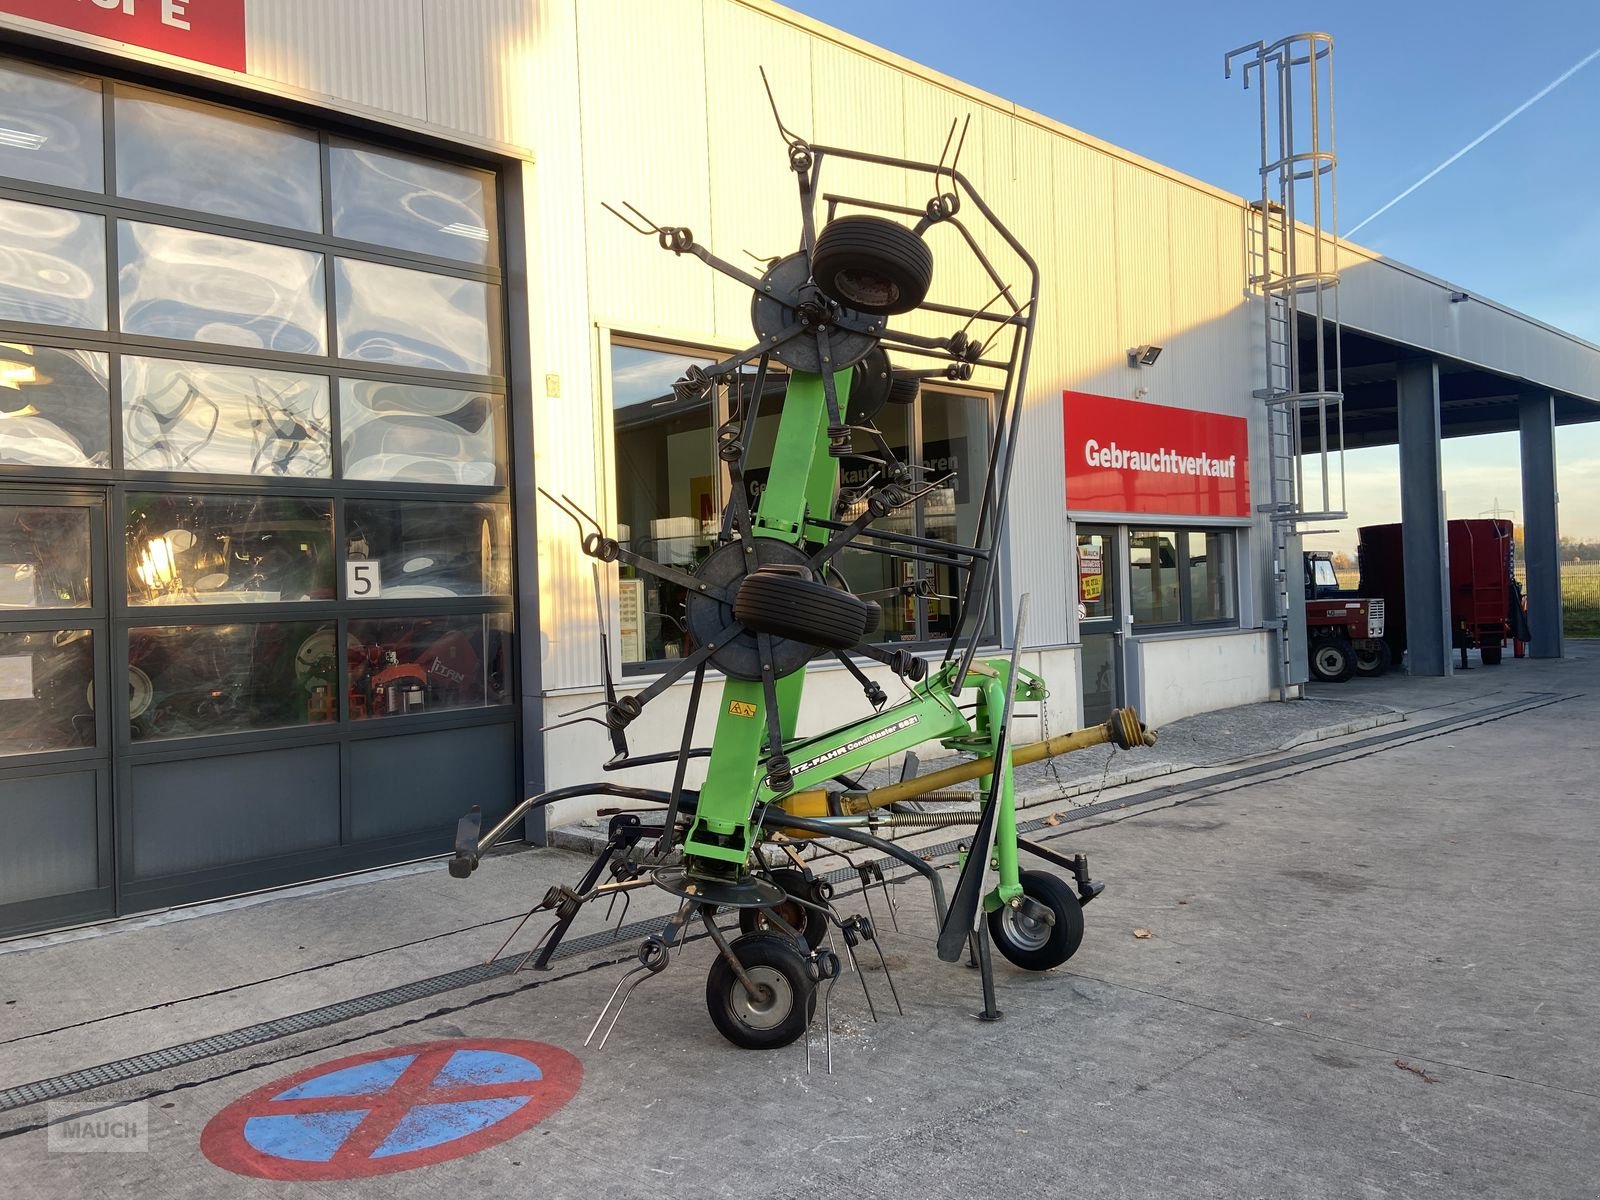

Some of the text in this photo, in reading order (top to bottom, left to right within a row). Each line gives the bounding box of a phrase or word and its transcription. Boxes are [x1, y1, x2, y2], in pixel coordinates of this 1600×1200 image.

[1085, 439, 1236, 478] Gebrauchtverkauf
[354, 566, 371, 595] 5
[846, 725, 897, 751] CondiMaster
